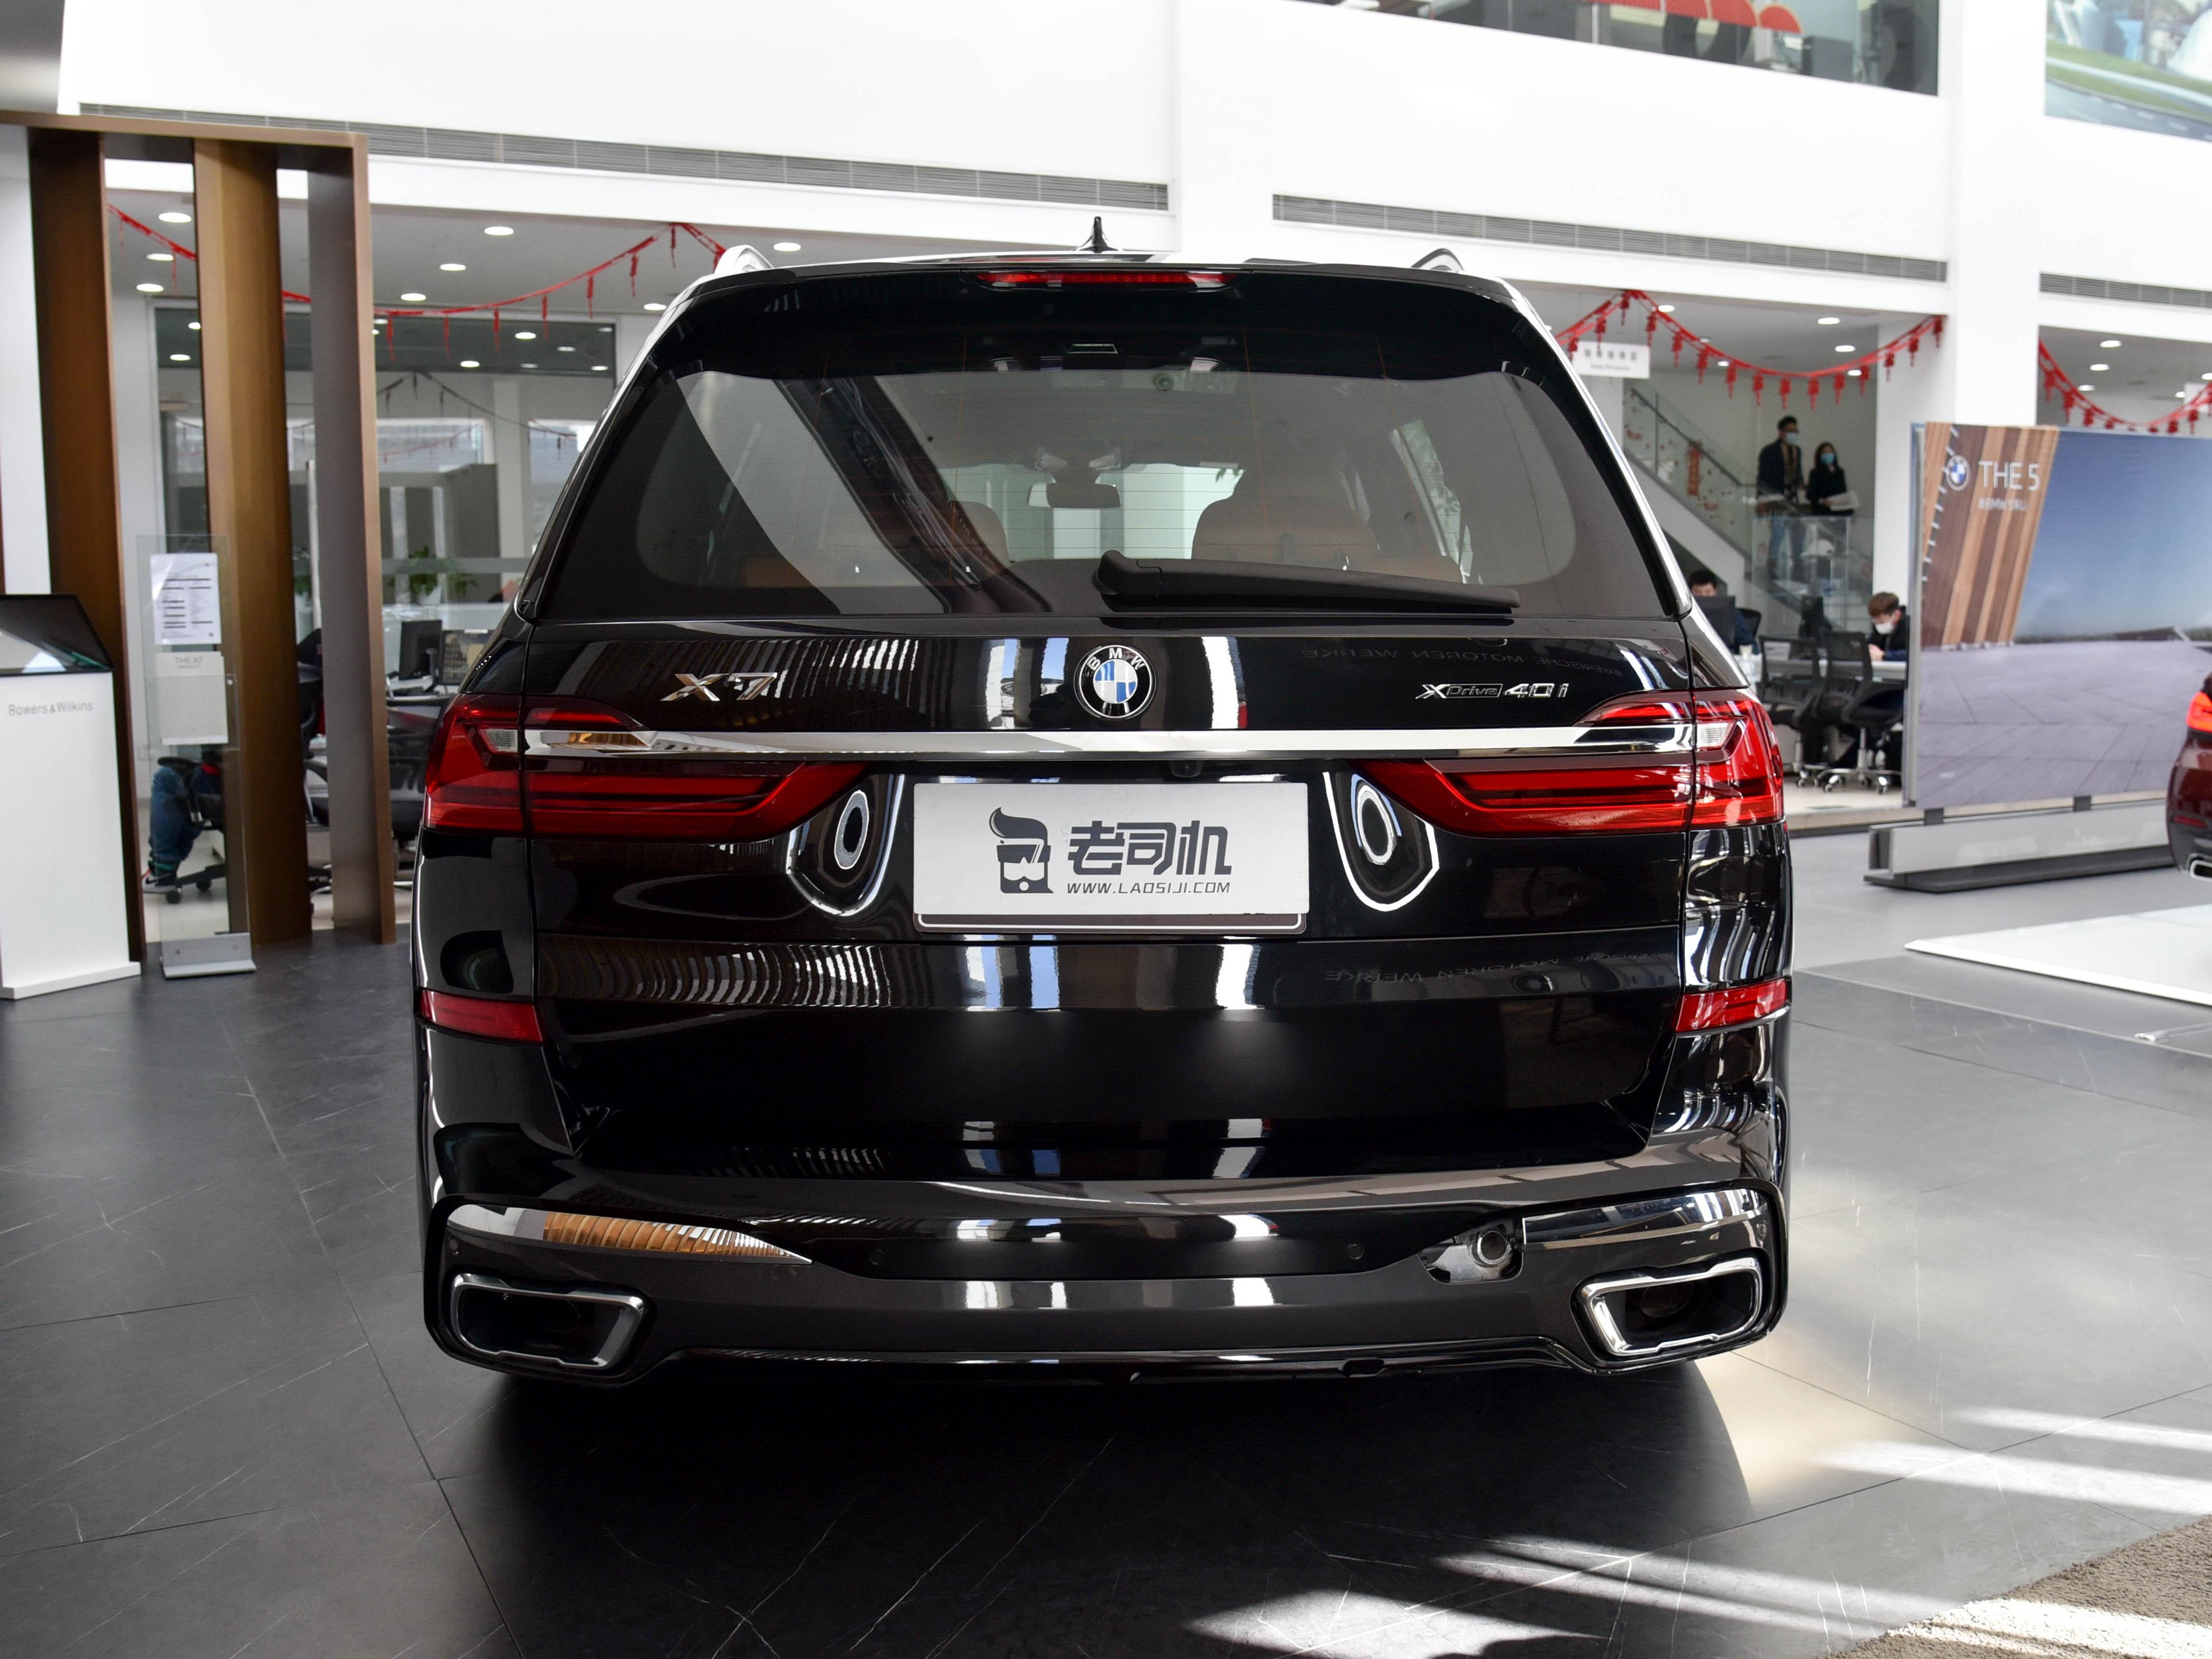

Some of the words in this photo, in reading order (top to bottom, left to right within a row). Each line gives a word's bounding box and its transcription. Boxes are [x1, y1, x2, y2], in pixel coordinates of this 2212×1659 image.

[1978, 460, 2023, 490] THE
[2029, 464, 2040, 491] 5
[1087, 647, 1146, 671] BMW
[660, 672, 777, 701] X7
[1067, 820, 1232, 875] 老司机
[1067, 882, 1231, 894] WWW.LAOSIJI.COM
